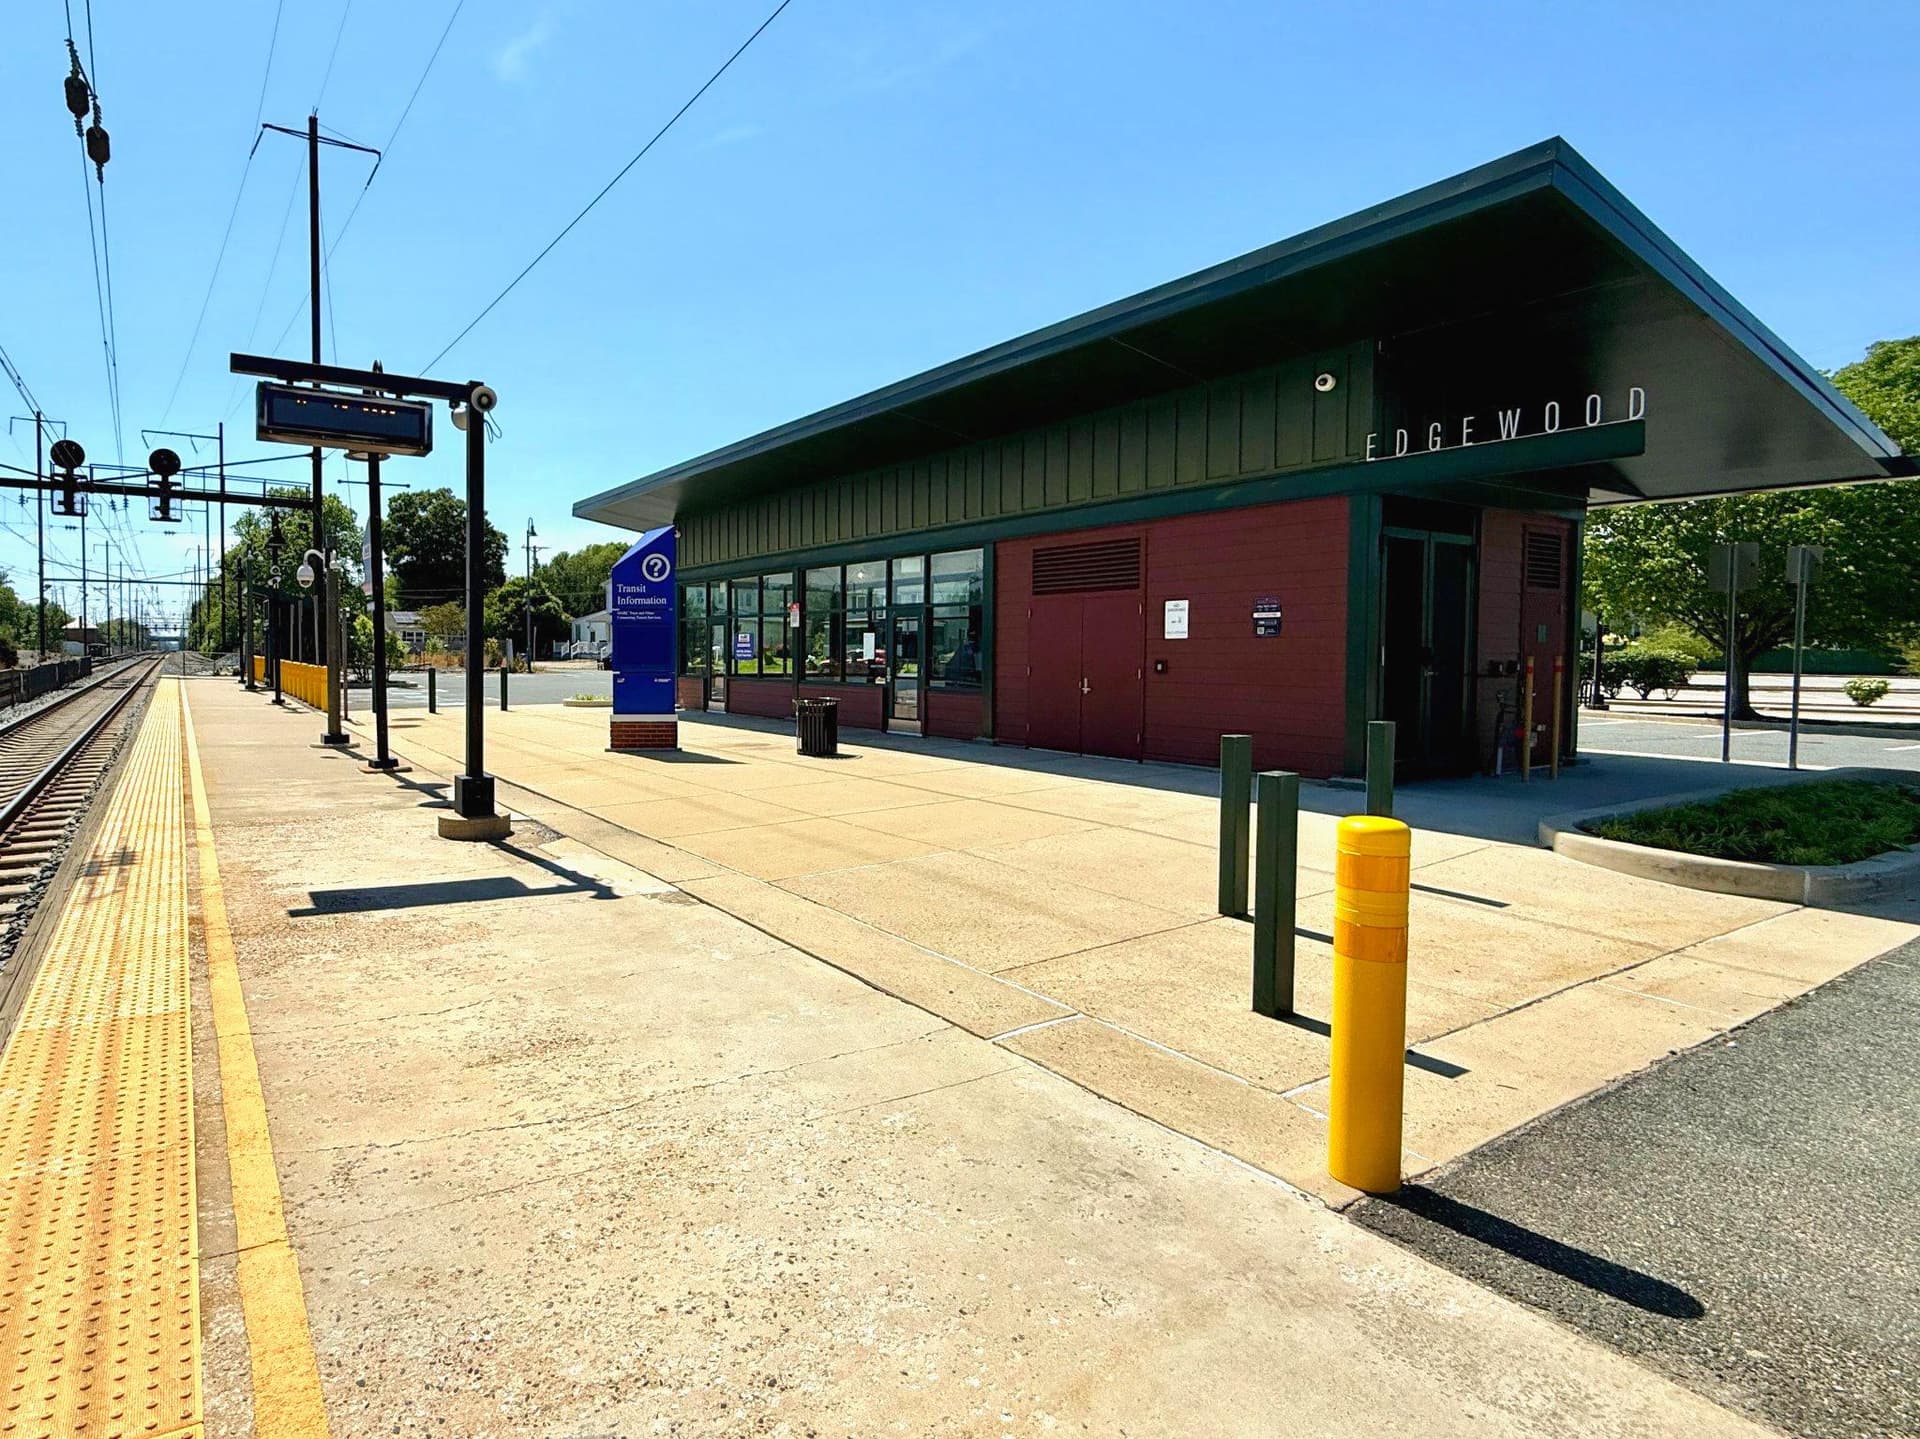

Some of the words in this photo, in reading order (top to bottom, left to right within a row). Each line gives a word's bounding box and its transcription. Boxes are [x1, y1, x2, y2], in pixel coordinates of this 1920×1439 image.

[1366, 387, 1646, 462] EDGEWOOD
[616, 583, 646, 593] Transit
[617, 595, 667, 605] Information
